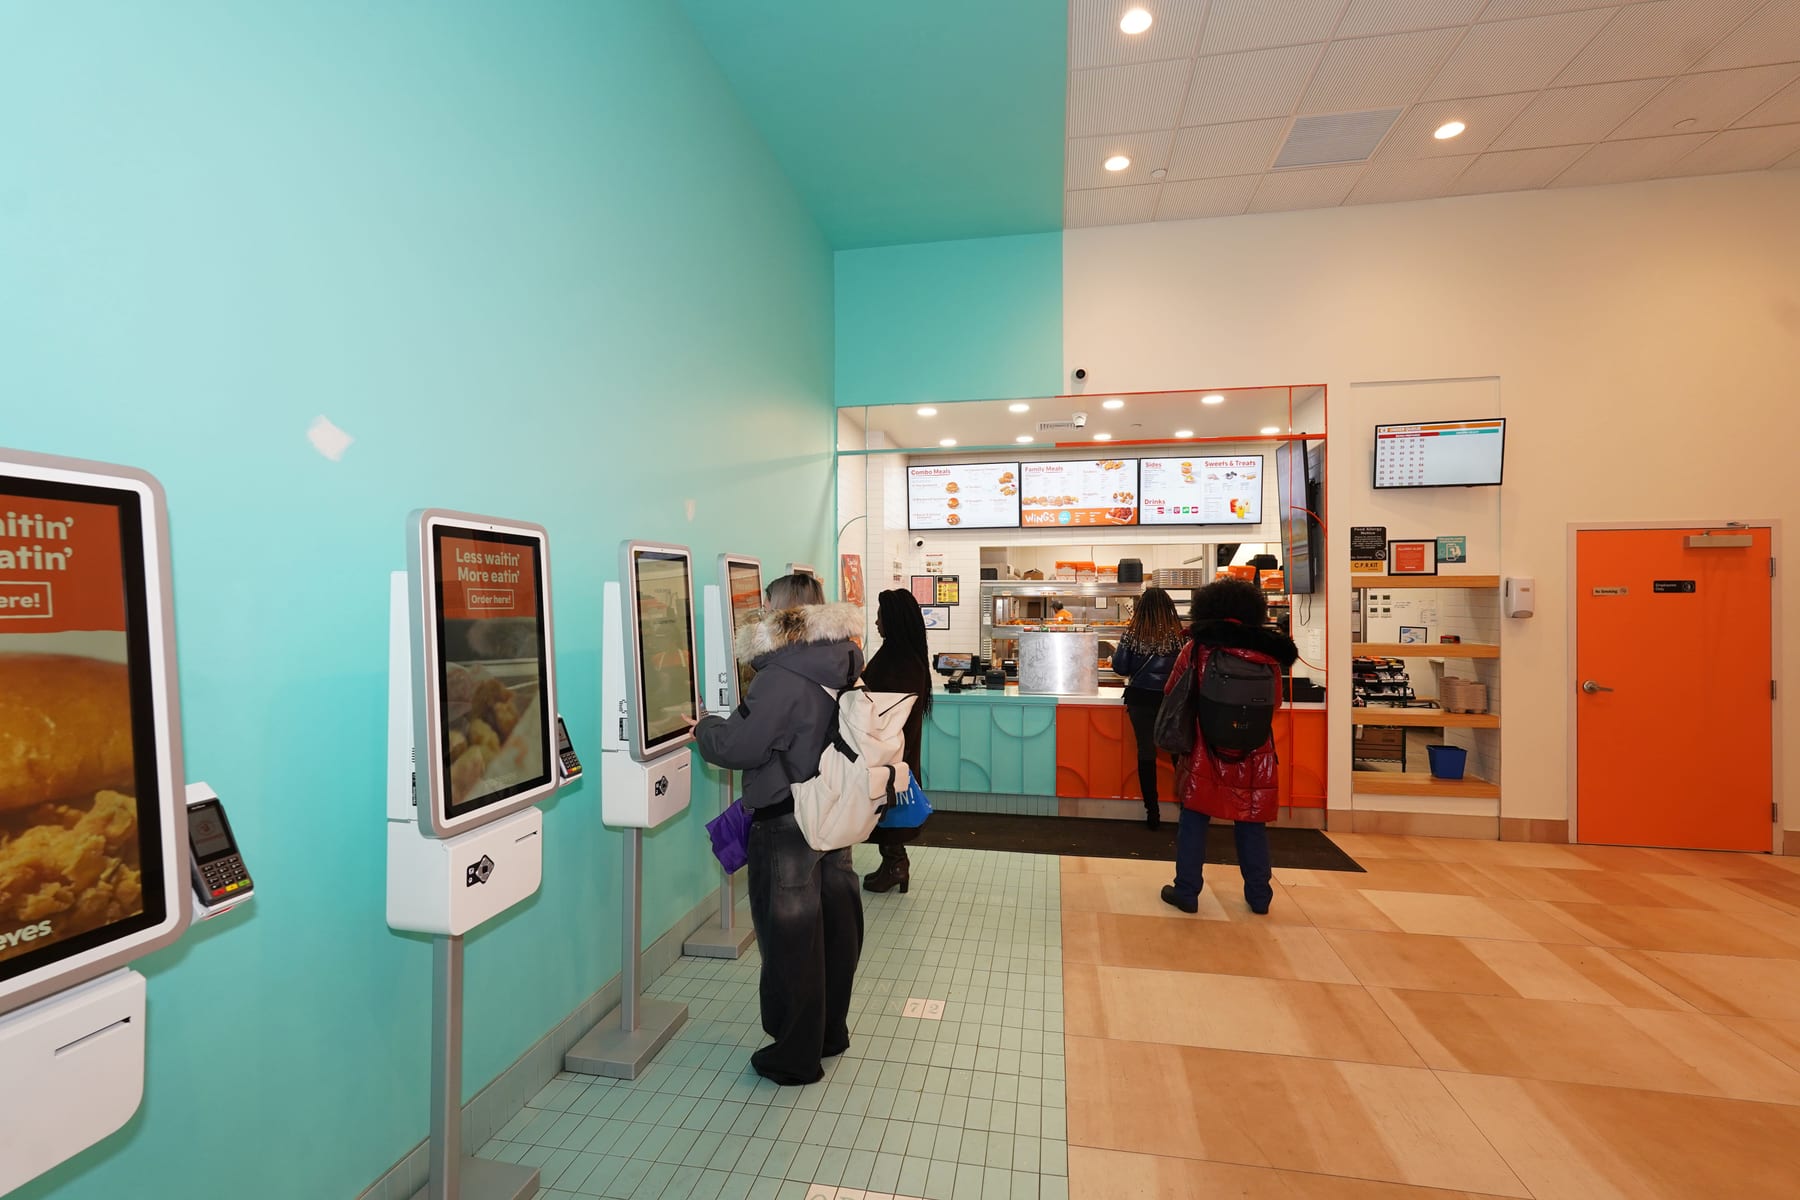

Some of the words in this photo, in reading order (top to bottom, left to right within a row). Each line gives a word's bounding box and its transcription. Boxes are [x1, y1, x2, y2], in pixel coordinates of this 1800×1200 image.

[456, 547, 482, 564] Less
[484, 551, 520, 567] waitin'
[457, 566, 489, 582] More
[491, 569, 520, 583] eatin'
[471, 594, 492, 604] Order
[493, 595, 511, 604] here!
